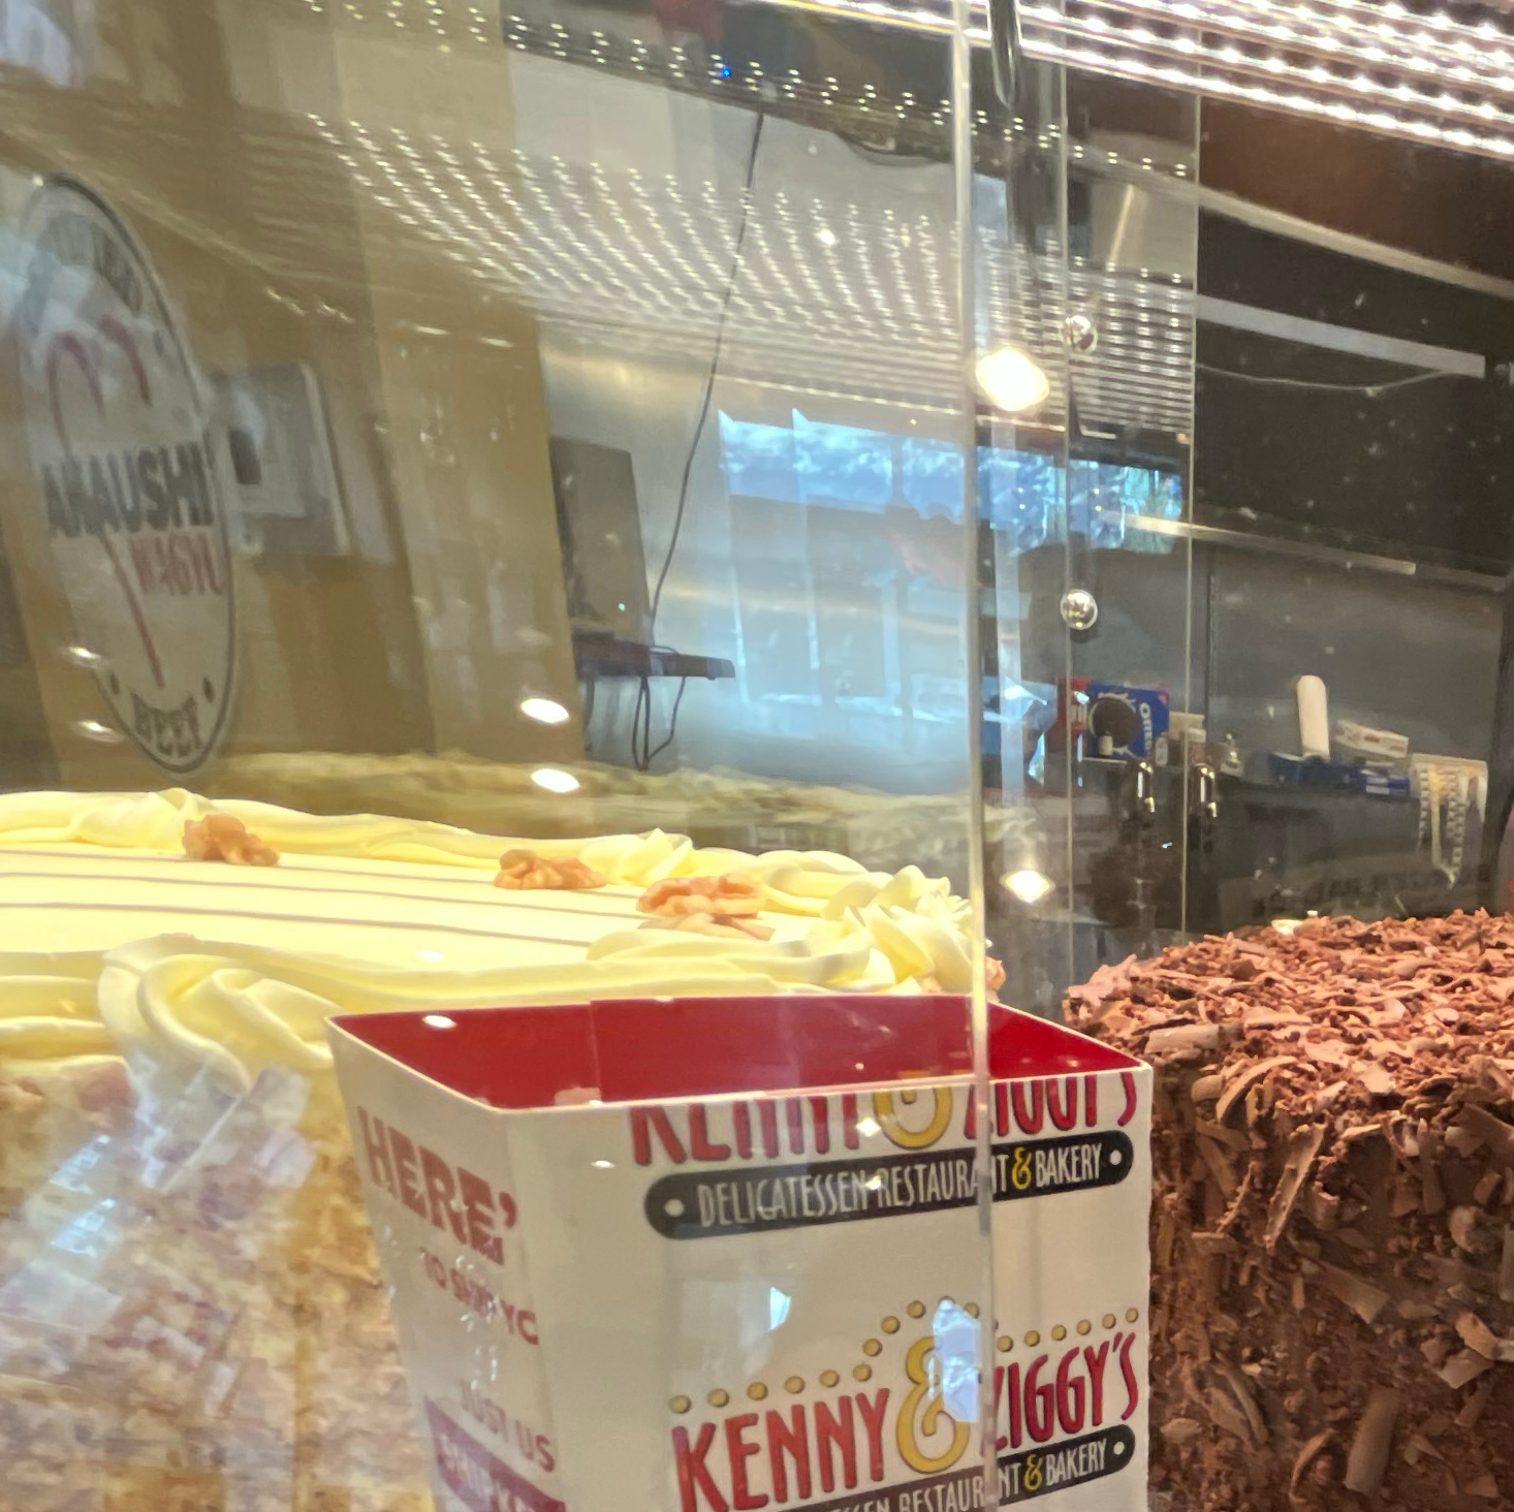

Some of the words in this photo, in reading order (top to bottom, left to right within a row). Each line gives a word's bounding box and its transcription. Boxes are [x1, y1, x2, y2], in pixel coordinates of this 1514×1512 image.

[697, 1169, 869, 1228] DELICATESSEN
[1011, 1146, 1032, 1190] &
[1035, 1142, 1102, 1188] BAKERY
[1023, 1453, 1043, 1492] &
[1046, 1437, 1108, 1487] BAKERY
